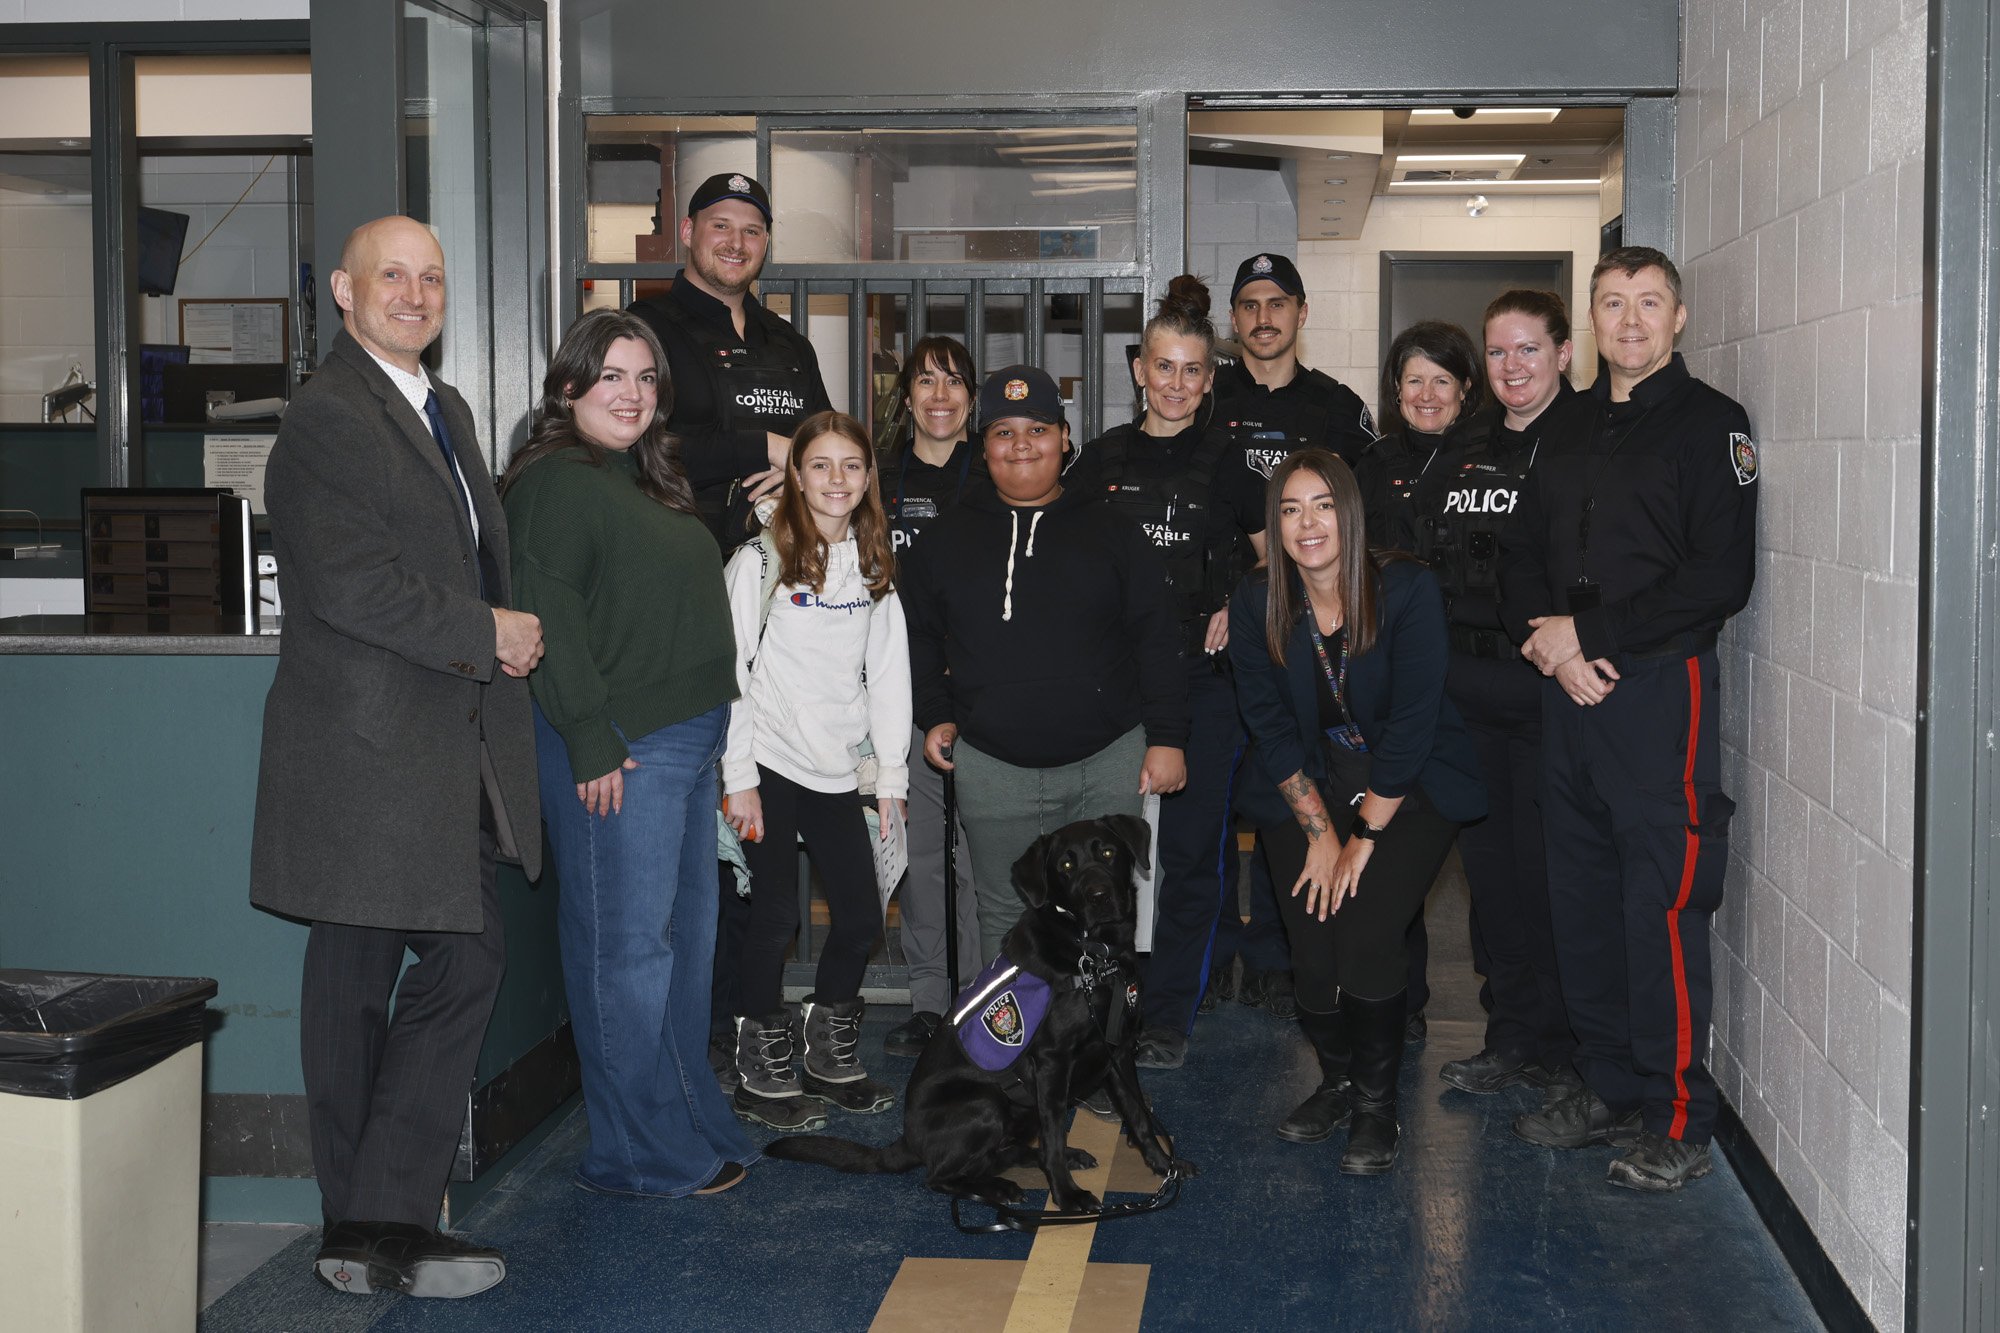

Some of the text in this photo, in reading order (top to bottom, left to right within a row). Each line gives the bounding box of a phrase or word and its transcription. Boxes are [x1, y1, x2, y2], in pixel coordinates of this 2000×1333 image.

[753, 388, 793, 398] SPECIAL
[1248, 449, 1289, 457] PECIAL
[1475, 464, 1497, 472] BARBER
[1142, 523, 1172, 532] CIAL
[1144, 529, 1191, 541] TABLE
[790, 592, 871, 615] Champion
[985, 994, 1010, 1021] POLICE
